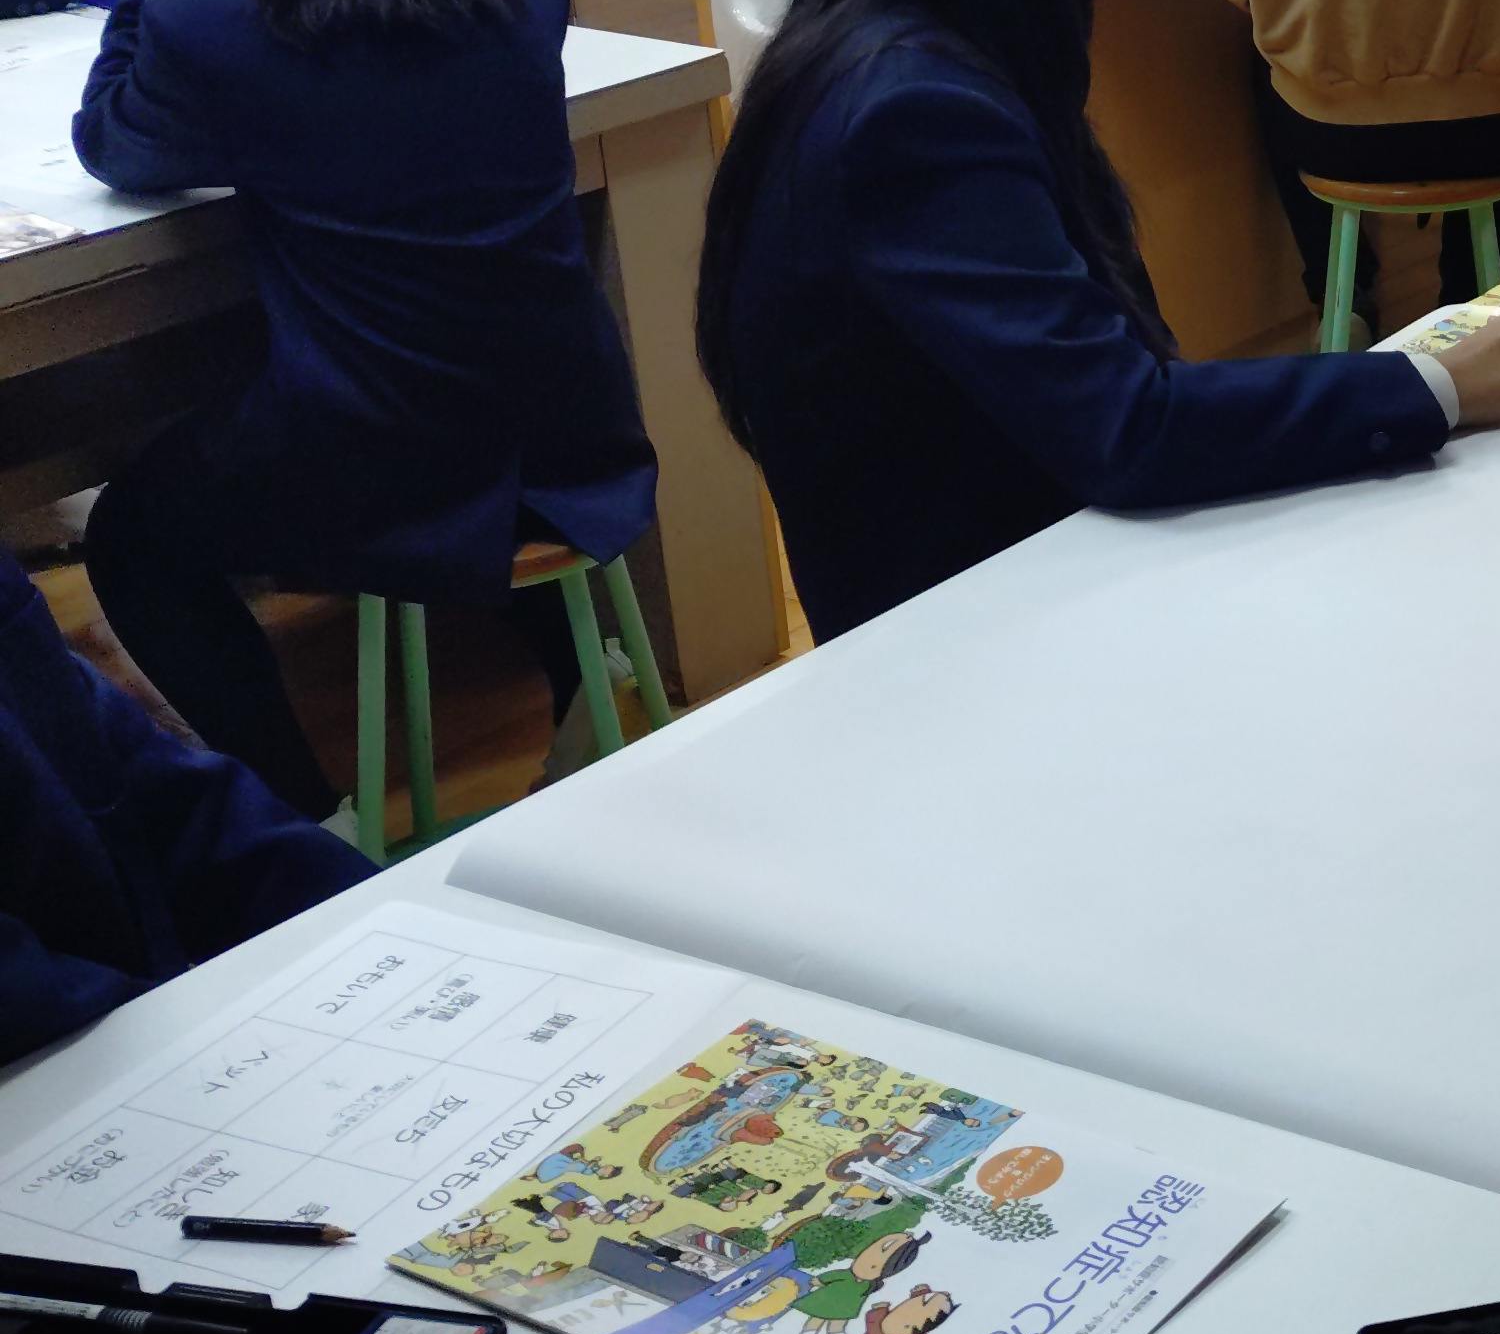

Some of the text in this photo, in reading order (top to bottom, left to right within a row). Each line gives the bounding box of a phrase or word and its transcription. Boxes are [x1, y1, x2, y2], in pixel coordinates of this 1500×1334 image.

[316, 955, 405, 1014] おもいで
[523, 1013, 577, 1044] 健康
[204, 1051, 269, 1094] ペット
[395, 1095, 468, 1143] 友だち
[417, 1072, 605, 1211] 私の大切なもの
[64, 1150, 125, 1184] お金
[154, 1160, 239, 1221] 知しき
